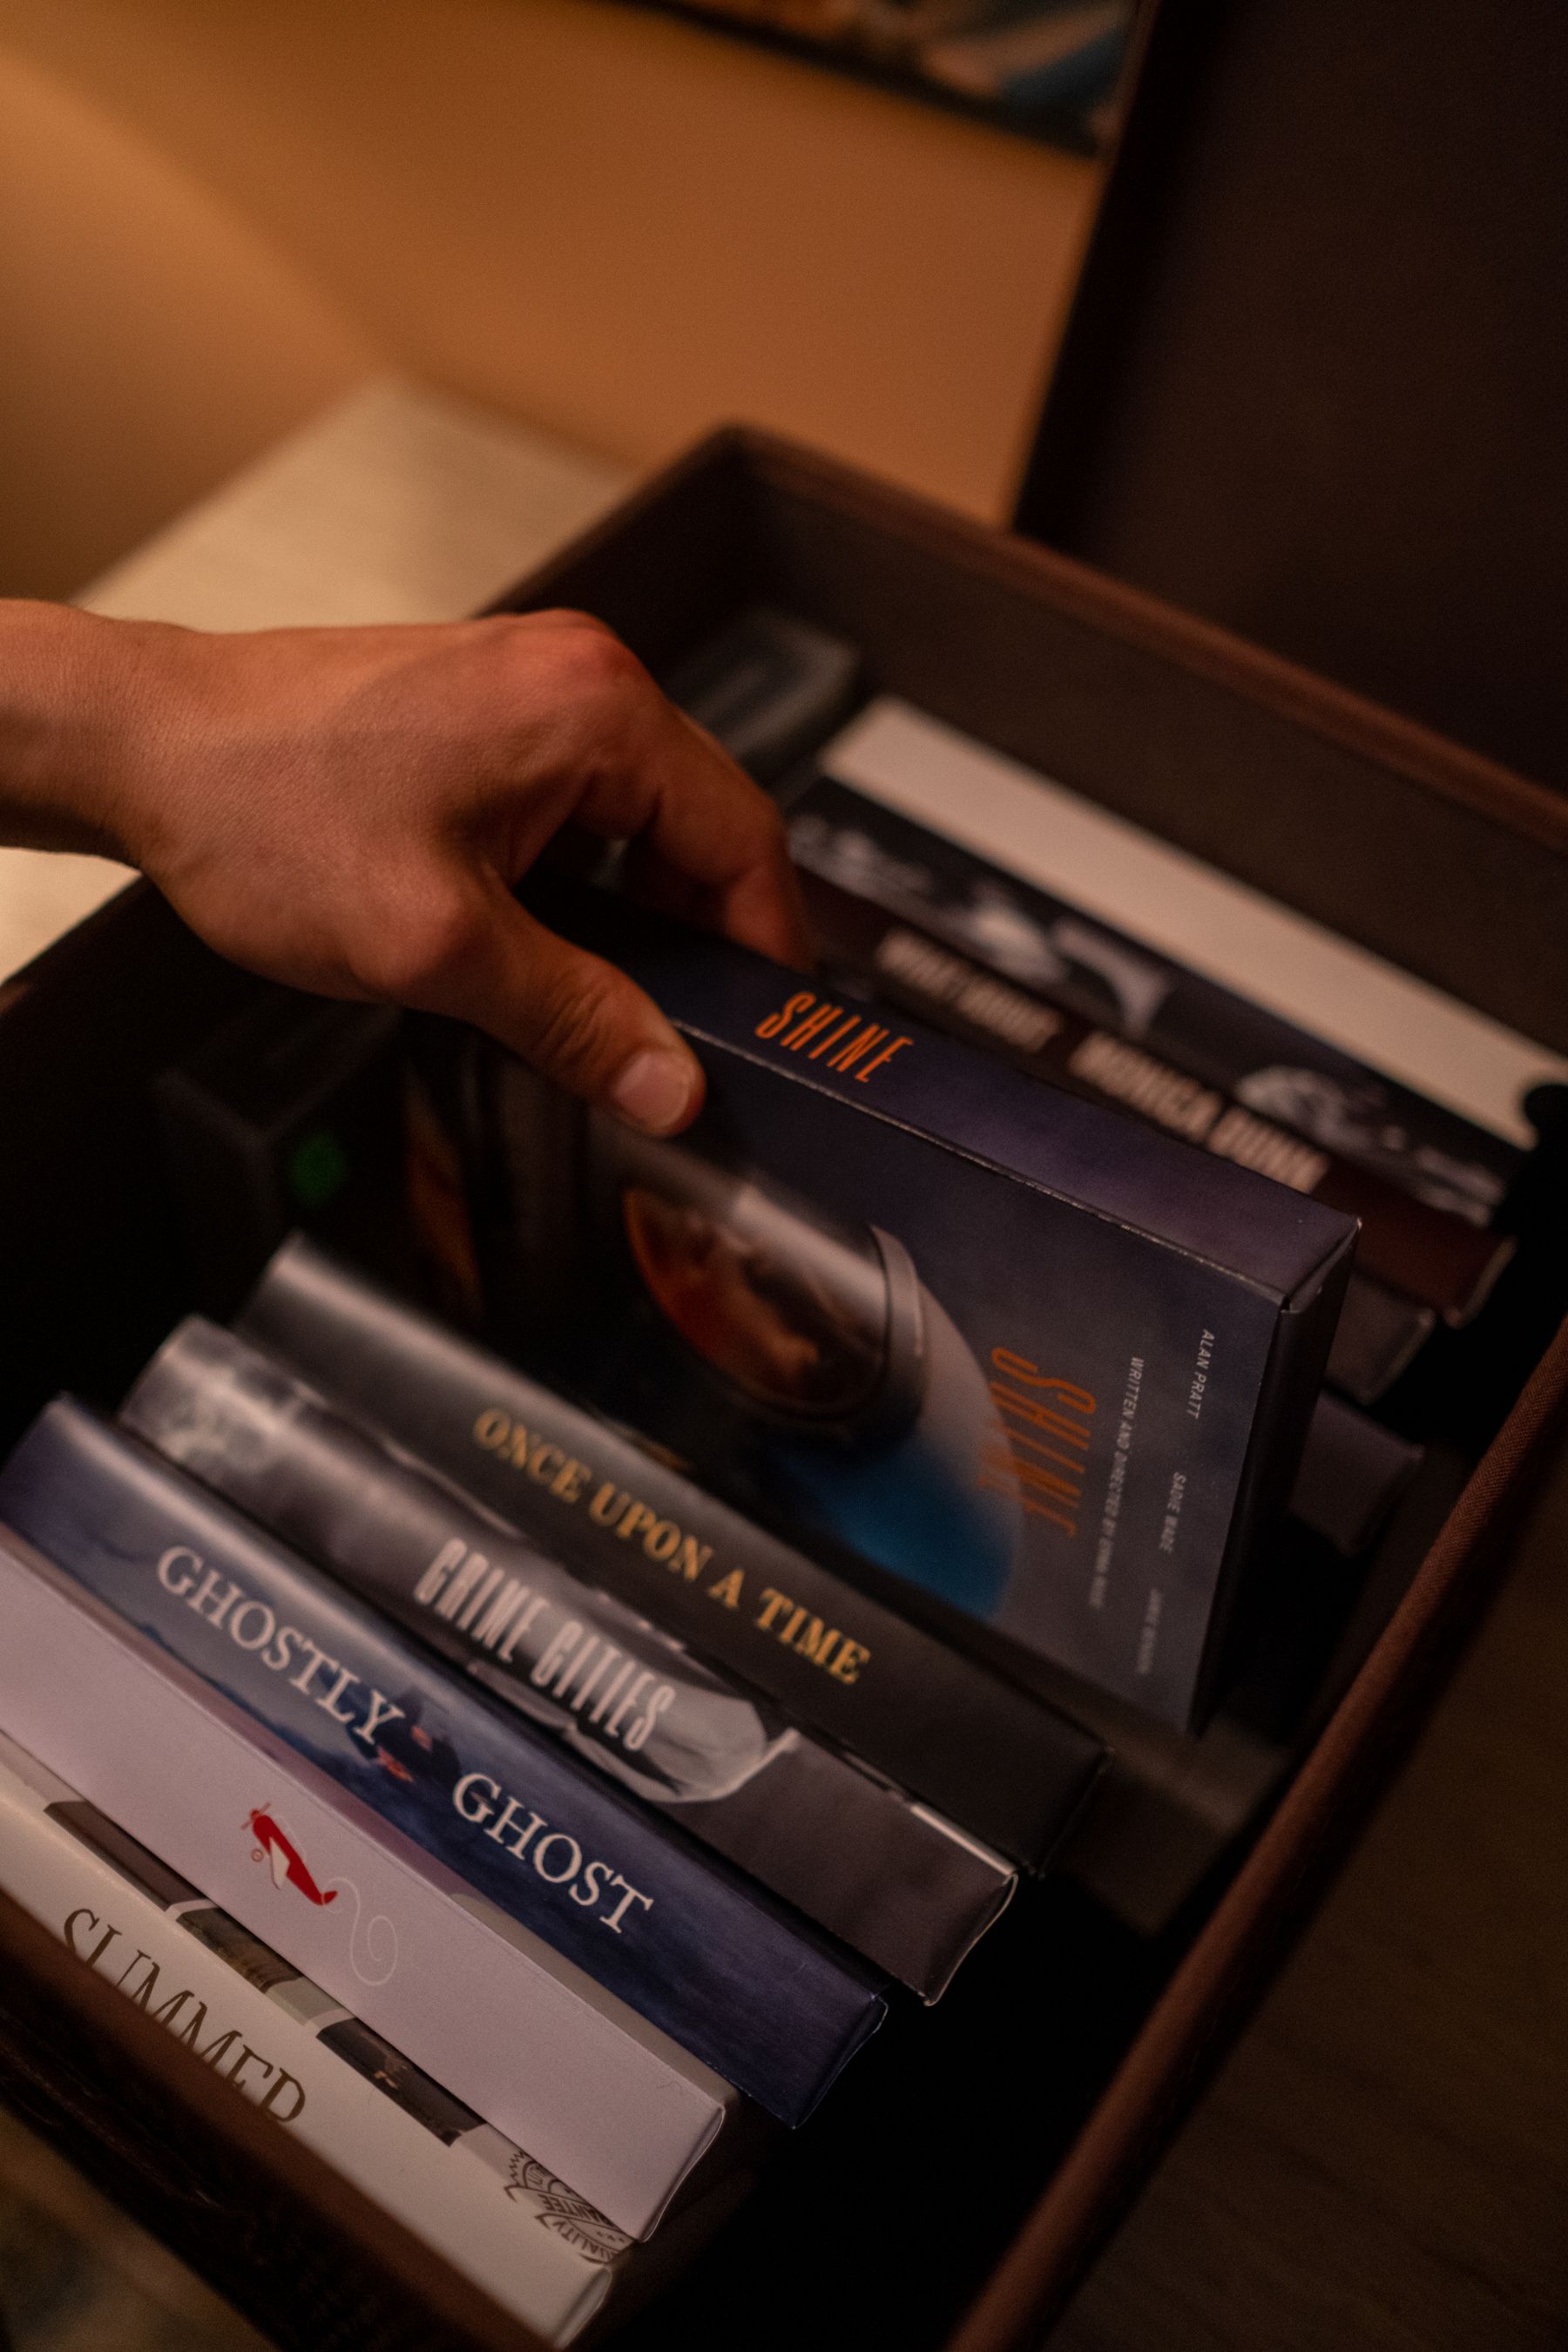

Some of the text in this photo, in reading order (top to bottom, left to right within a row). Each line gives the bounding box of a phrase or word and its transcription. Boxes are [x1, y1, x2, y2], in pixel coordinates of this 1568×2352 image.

[755, 990, 914, 1083] SHINE
[1122, 1356, 1145, 1421] WRITTEN
[1186, 1328, 1216, 1420] ALAN PRATT
[473, 1407, 871, 1686] ONCE UPON A TIME
[412, 1538, 677, 1754] CRIME CITIES
[156, 1545, 655, 1935] GHOSTLY GHOST
